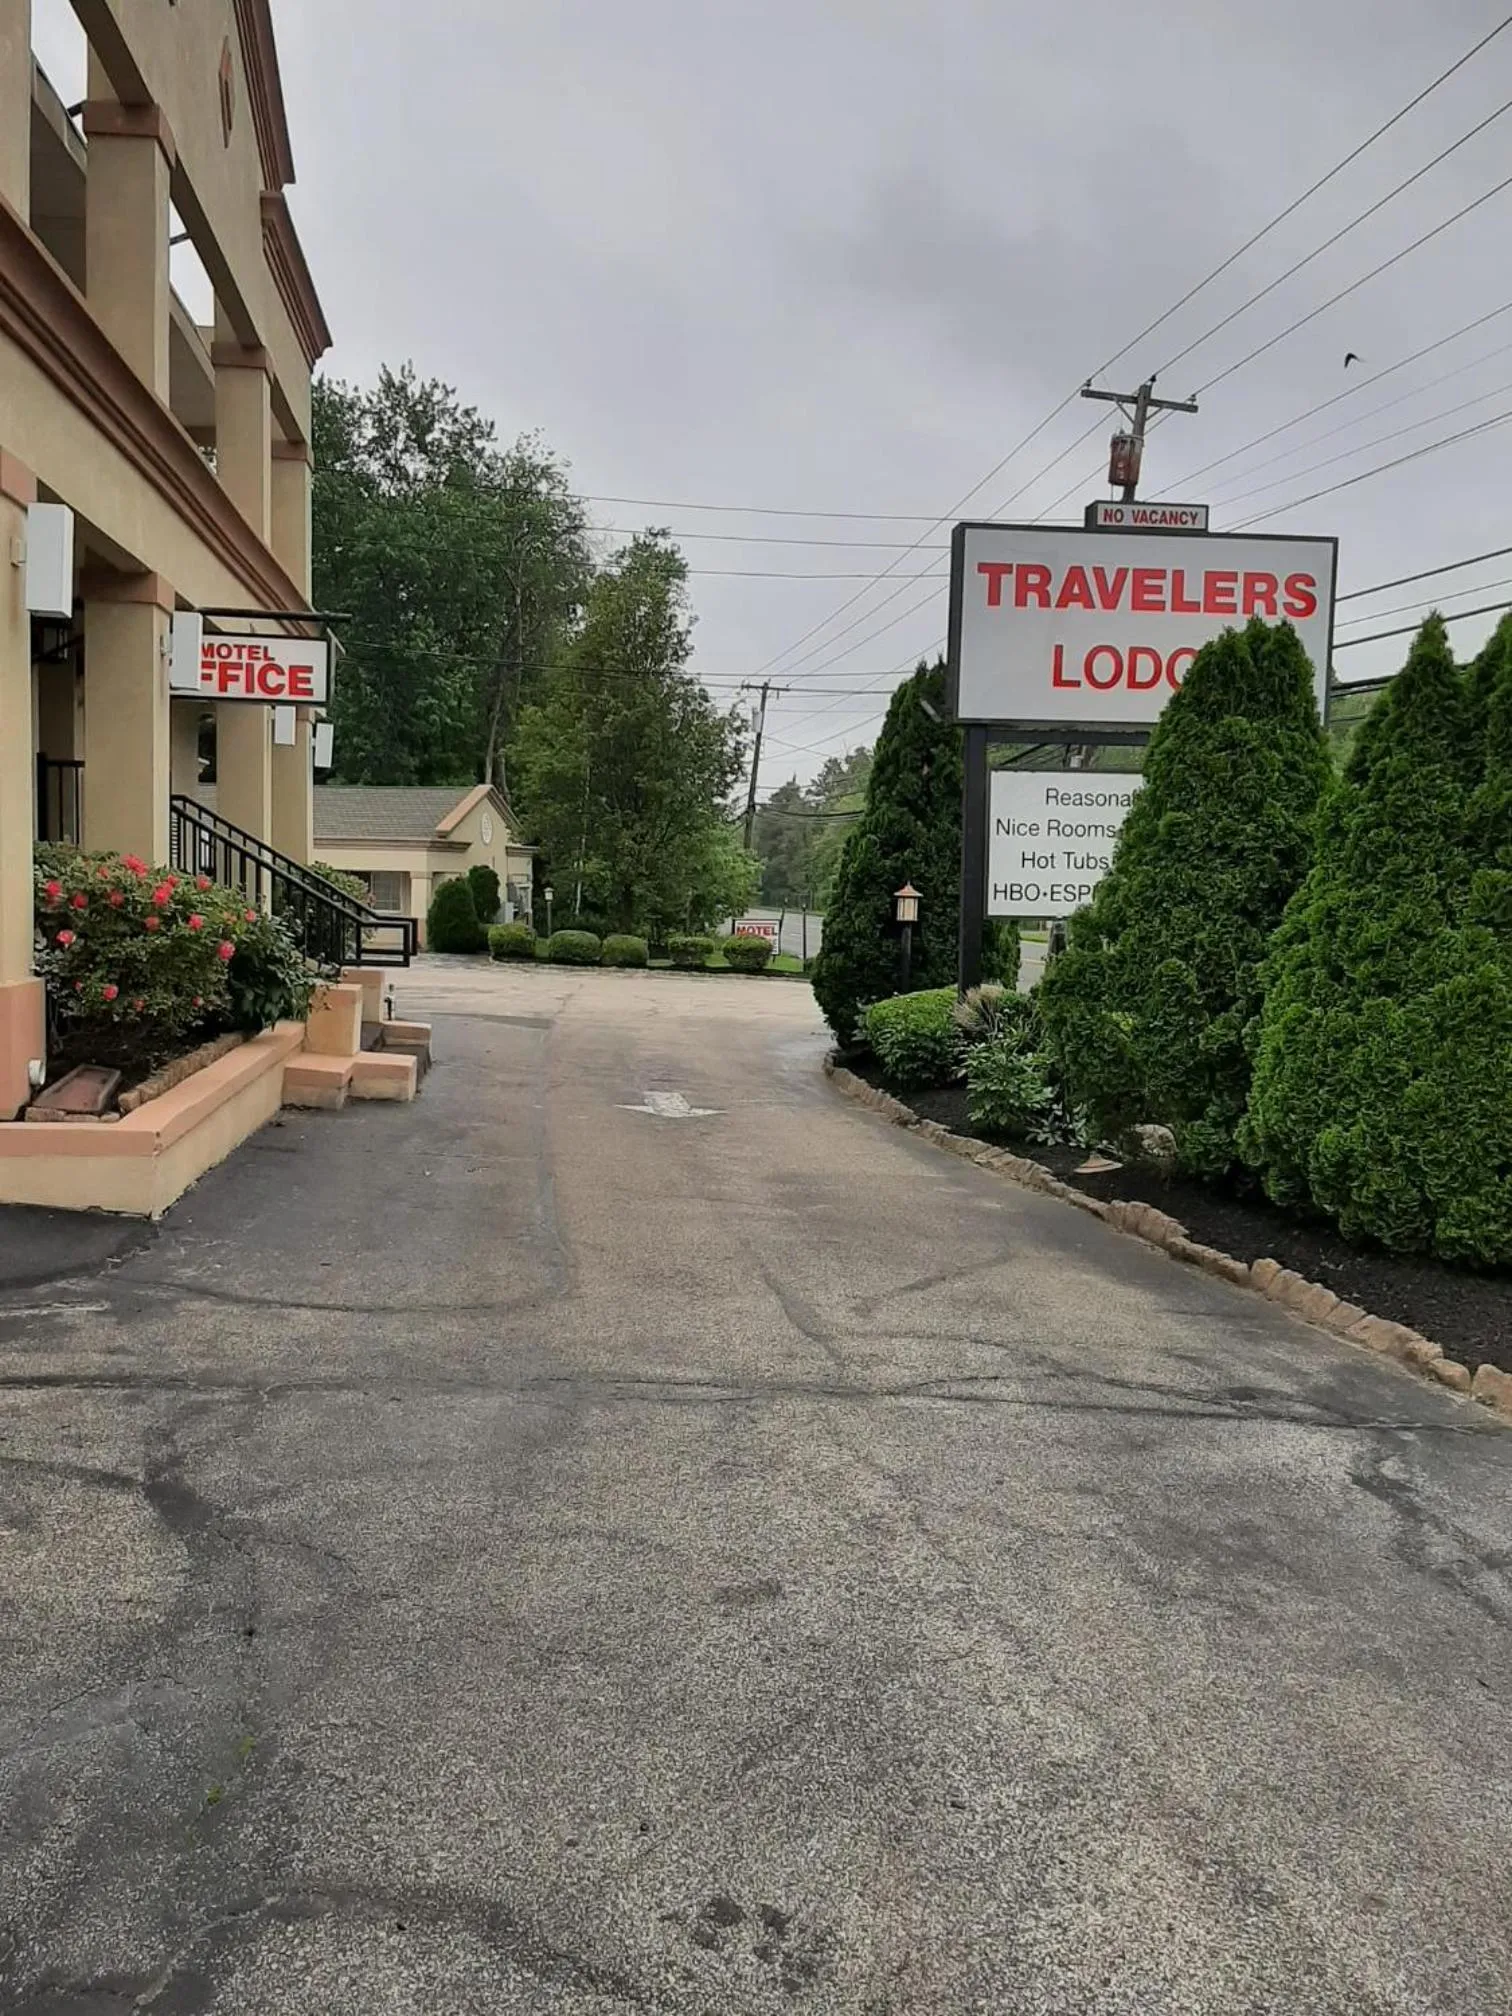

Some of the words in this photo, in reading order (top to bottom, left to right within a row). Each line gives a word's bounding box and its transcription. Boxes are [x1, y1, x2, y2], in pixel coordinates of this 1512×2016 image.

[1103, 508, 1124, 523] NO
[1132, 510, 1198, 525] VACANCY
[977, 562, 1317, 617] TRAVELERS
[201, 642, 276, 661] MOTEL
[1045, 787, 1134, 807] Reasona
[996, 818, 1040, 837] Nice
[1047, 819, 1116, 838] Rooms
[1021, 851, 1056, 869] Hot
[1063, 851, 1109, 870] Tubs
